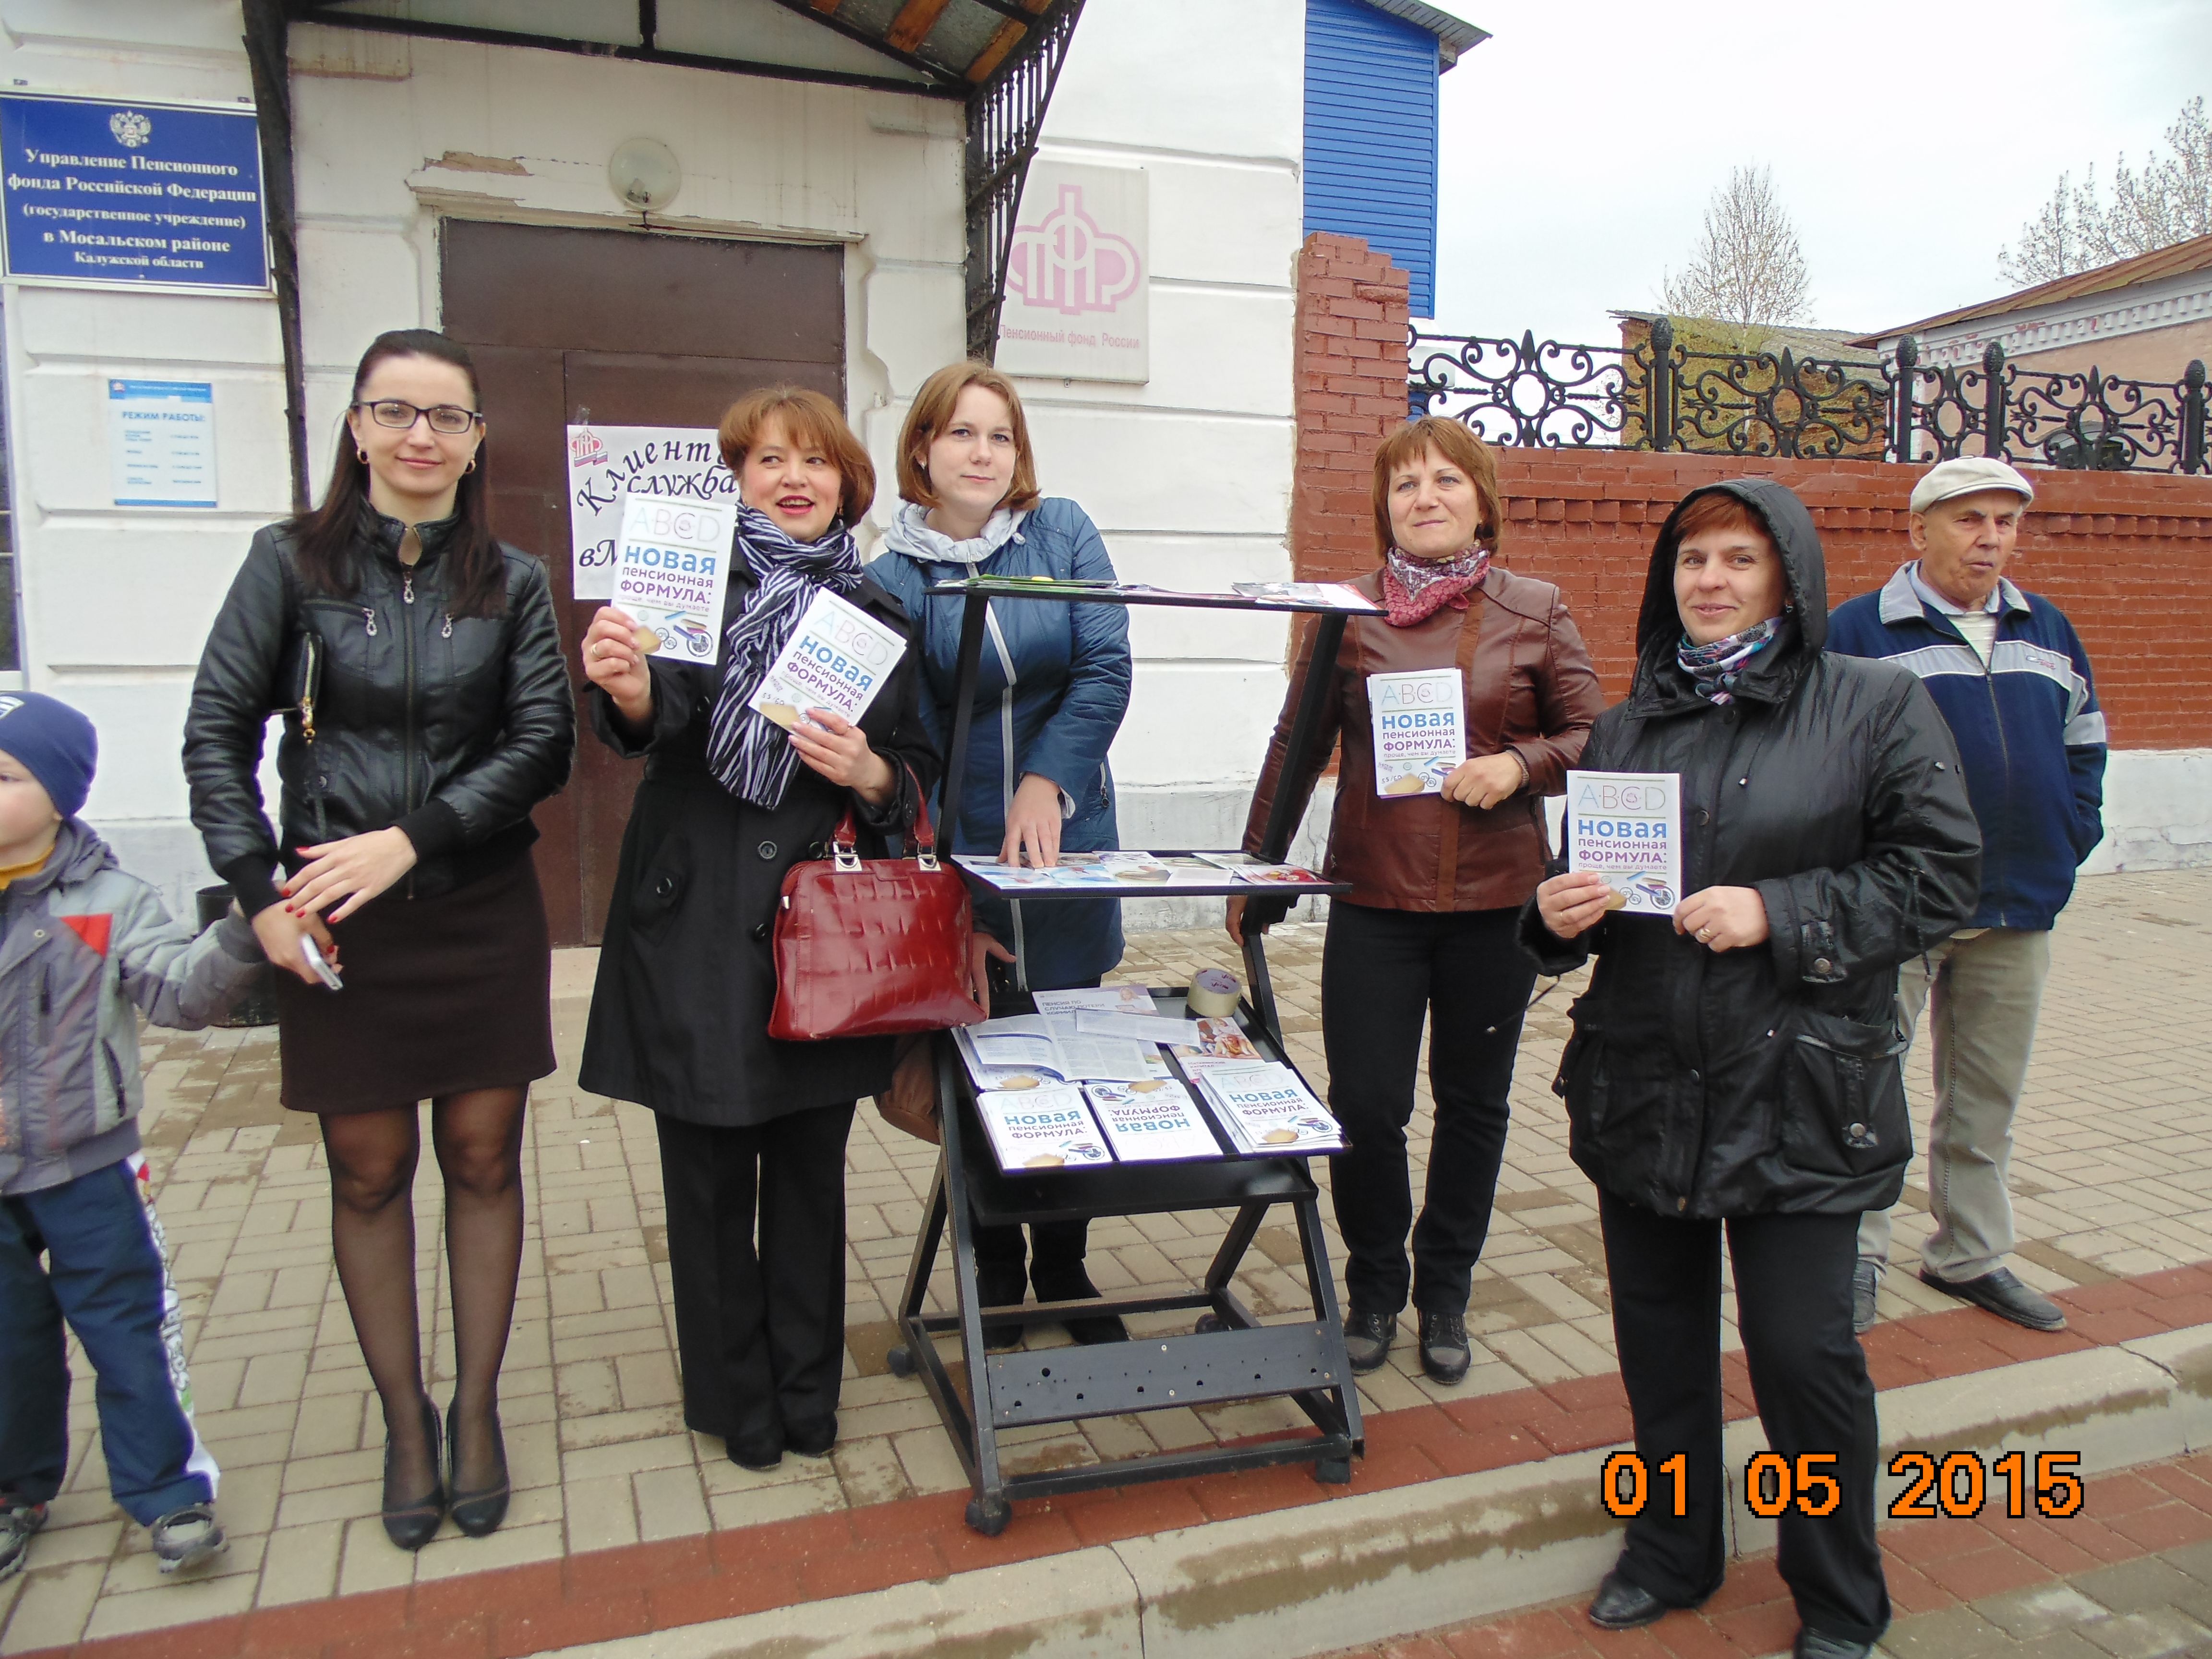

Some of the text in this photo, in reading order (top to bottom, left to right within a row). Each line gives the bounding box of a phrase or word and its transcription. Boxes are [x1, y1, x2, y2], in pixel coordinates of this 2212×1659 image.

[25, 148, 238, 176] Управление Пенсионного
[8, 173, 257, 202] фонда Российской Федерации
[23, 204, 246, 229] (государственное учреждение)
[44, 229, 230, 252] в Мосальском районе
[74, 252, 204, 269] Калужской области
[999, 325, 1139, 349] Пенсионный фонд России
[123, 411, 159, 420] РЕЖИМ
[627, 465, 737, 500] служба
[625, 545, 716, 575] новая
[622, 567, 713, 588] пенсионная
[621, 579, 711, 604] ФОРМУЛА:
[799, 635, 873, 692] новая
[793, 651, 864, 701] пенсионная
[787, 661, 858, 712] ФОРМУЛА:
[1382, 712, 1455, 730] новая
[1383, 729, 1455, 739] пенсионная
[1383, 738, 1455, 752] ФОРМУЛА:
[1578, 819, 1666, 838] новая
[1578, 838, 1667, 849] пенсионная
[1579, 850, 1667, 863] ФОРМУЛА:
[1229, 1089, 1298, 1102] новая
[1237, 1098, 1303, 1108] пенсионная
[1108, 1106, 1180, 1116] ФОРМУЛА:
[1112, 1113, 1184, 1122] пенсионная
[1242, 1103, 1309, 1115] ФОРМУЛА:
[1004, 1111, 1081, 1125] новая
[1009, 1121, 1084, 1131] пенсионная
[1012, 1127, 1087, 1138] ФОРМУЛА:
